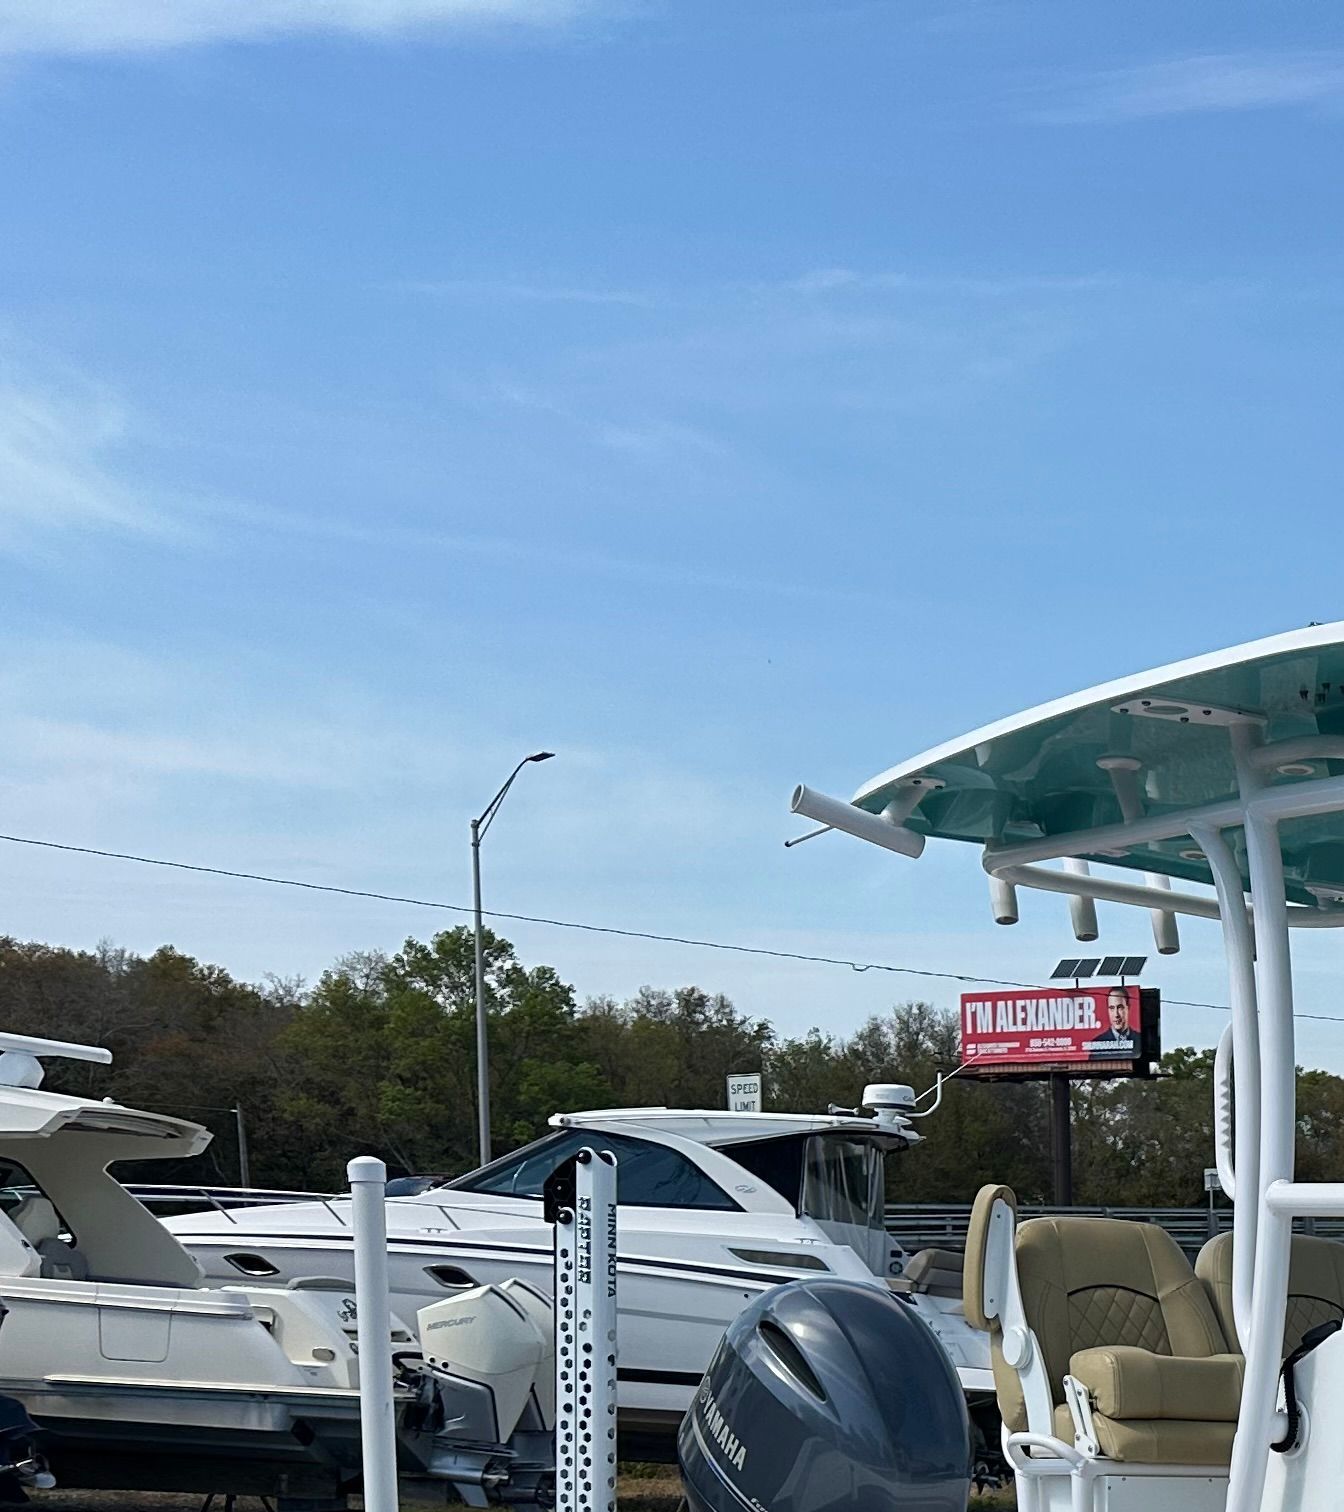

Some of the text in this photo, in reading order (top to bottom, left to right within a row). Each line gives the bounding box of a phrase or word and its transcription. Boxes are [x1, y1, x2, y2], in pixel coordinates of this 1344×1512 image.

[966, 996, 1102, 1034] I'M ALEXANDER.
[730, 1082, 759, 1095] SPEED
[734, 1100, 756, 1112] LIMIT
[607, 1203, 617, 1298] MINN KOTA
[426, 1315, 477, 1331] MERCURY
[703, 1390, 747, 1472] YAMAHA
